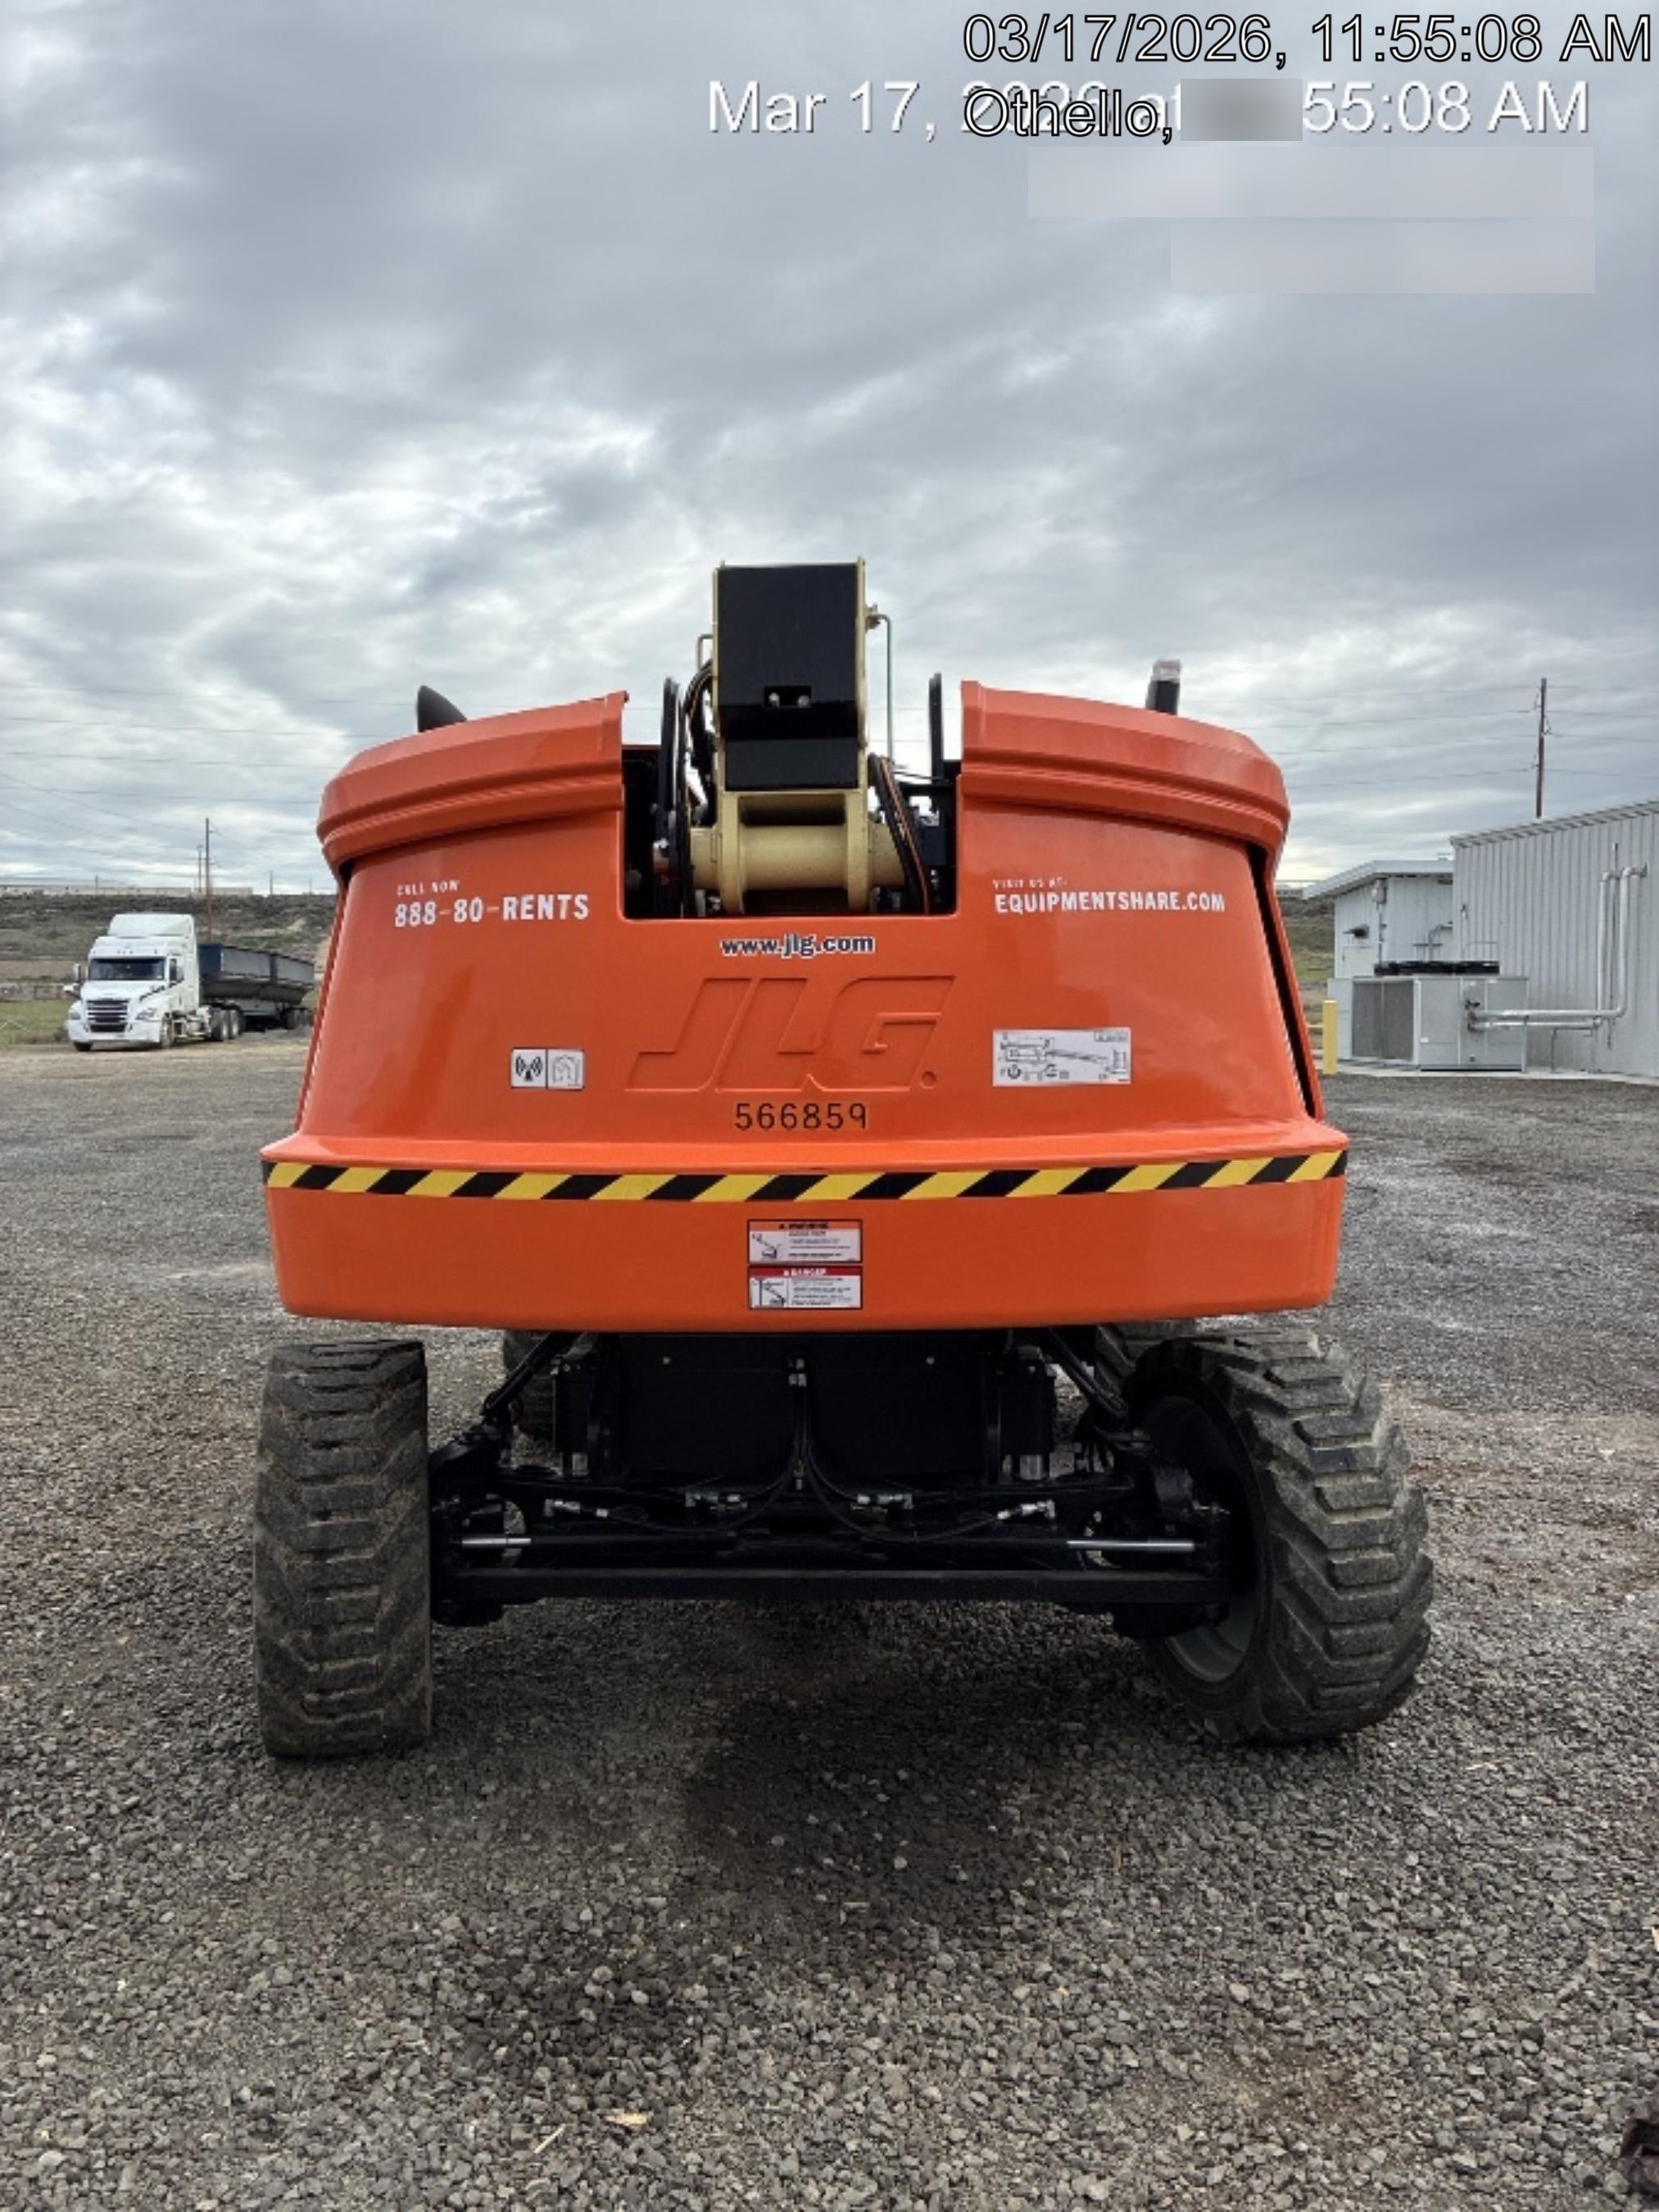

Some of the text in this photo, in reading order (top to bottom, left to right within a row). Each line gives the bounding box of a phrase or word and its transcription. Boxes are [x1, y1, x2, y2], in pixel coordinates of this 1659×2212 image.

[431, 879, 460, 894] NOW
[394, 893, 590, 928] 888-80-RENTS
[994, 891, 1226, 914] EQUIPMENTSHARE.COM
[719, 934, 875, 959] www.jlg.com
[734, 1102, 868, 1131] 566859
